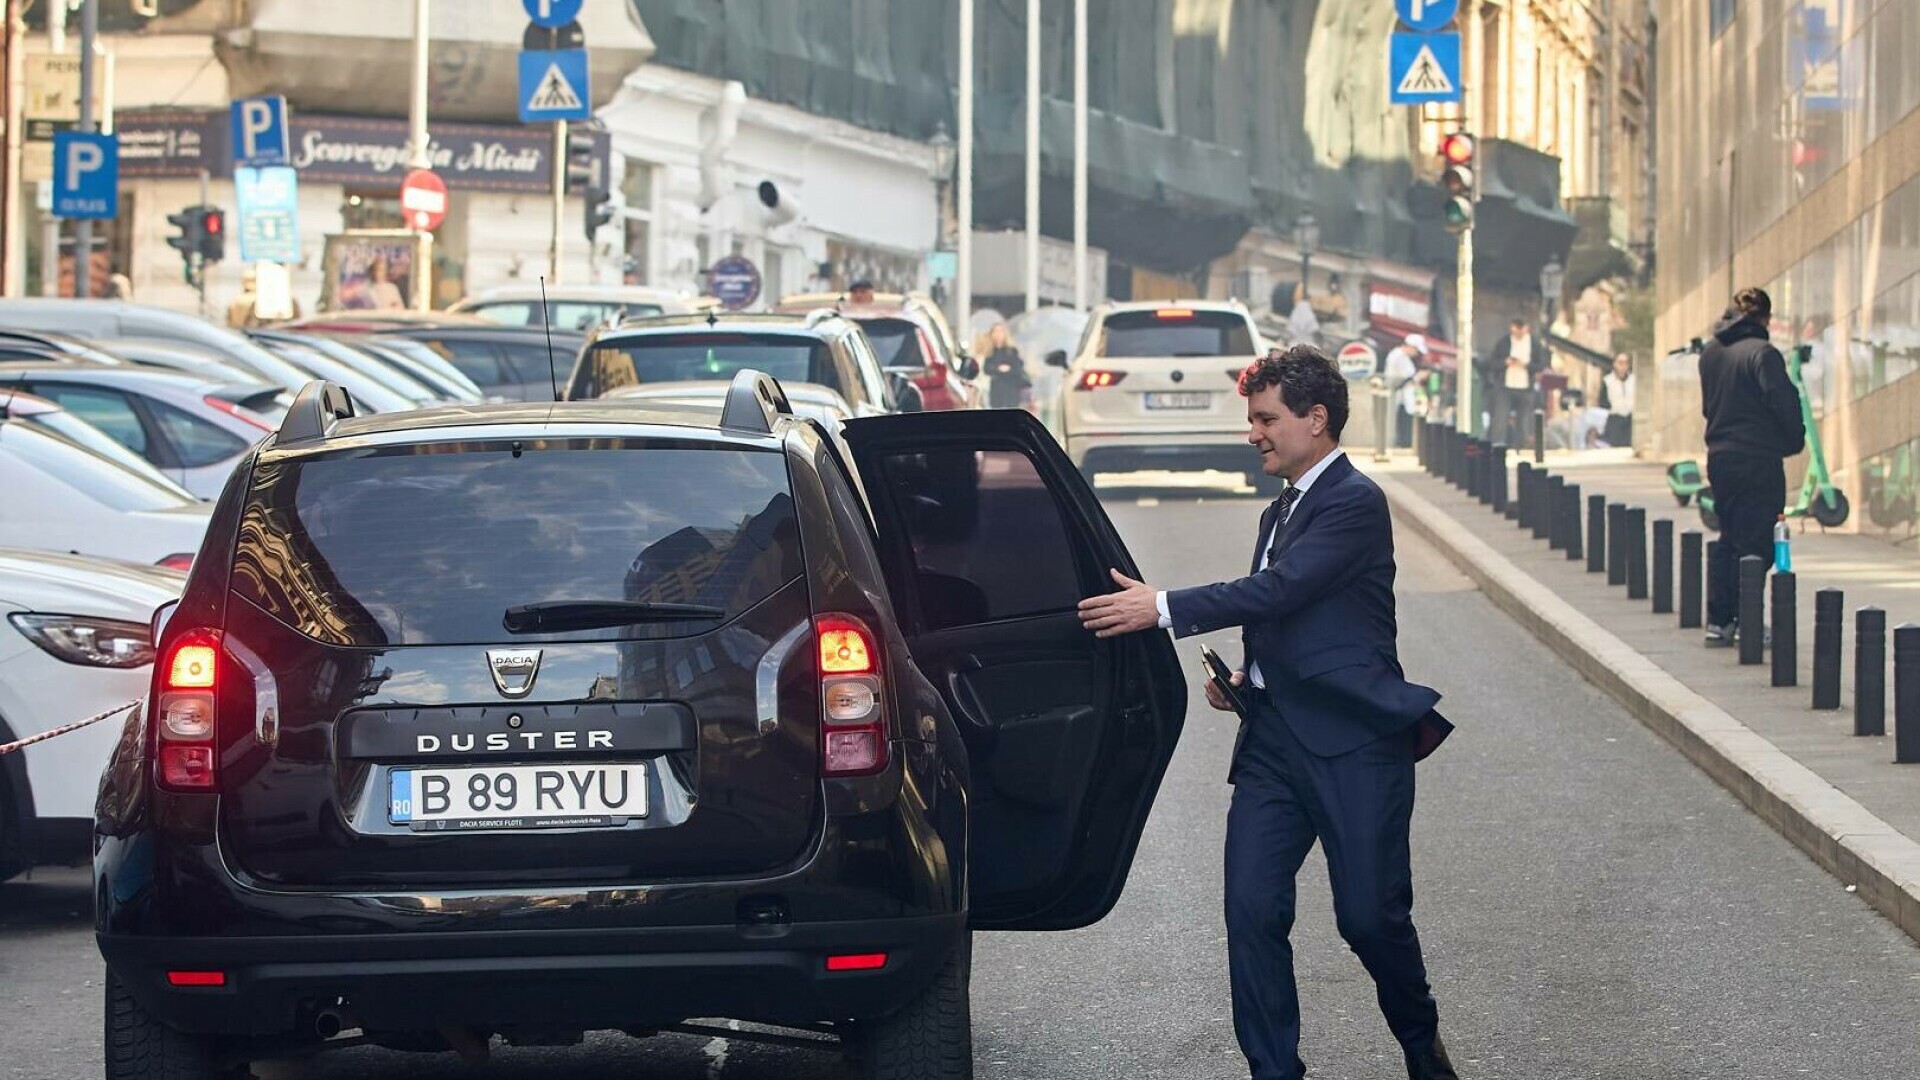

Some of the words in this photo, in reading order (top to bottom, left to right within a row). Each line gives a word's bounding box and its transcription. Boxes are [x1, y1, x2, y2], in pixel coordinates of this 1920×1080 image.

[242, 101, 272, 157] P
[66, 142, 104, 191] P
[495, 656, 533, 664] DACIA
[417, 730, 614, 753] DUSTER
[421, 775, 451, 815] B
[468, 772, 518, 811] 89
[535, 769, 628, 810] RYU
[393, 799, 411, 816] RO
[459, 820, 478, 828] DACIA
[504, 818, 523, 827] FLOTE
